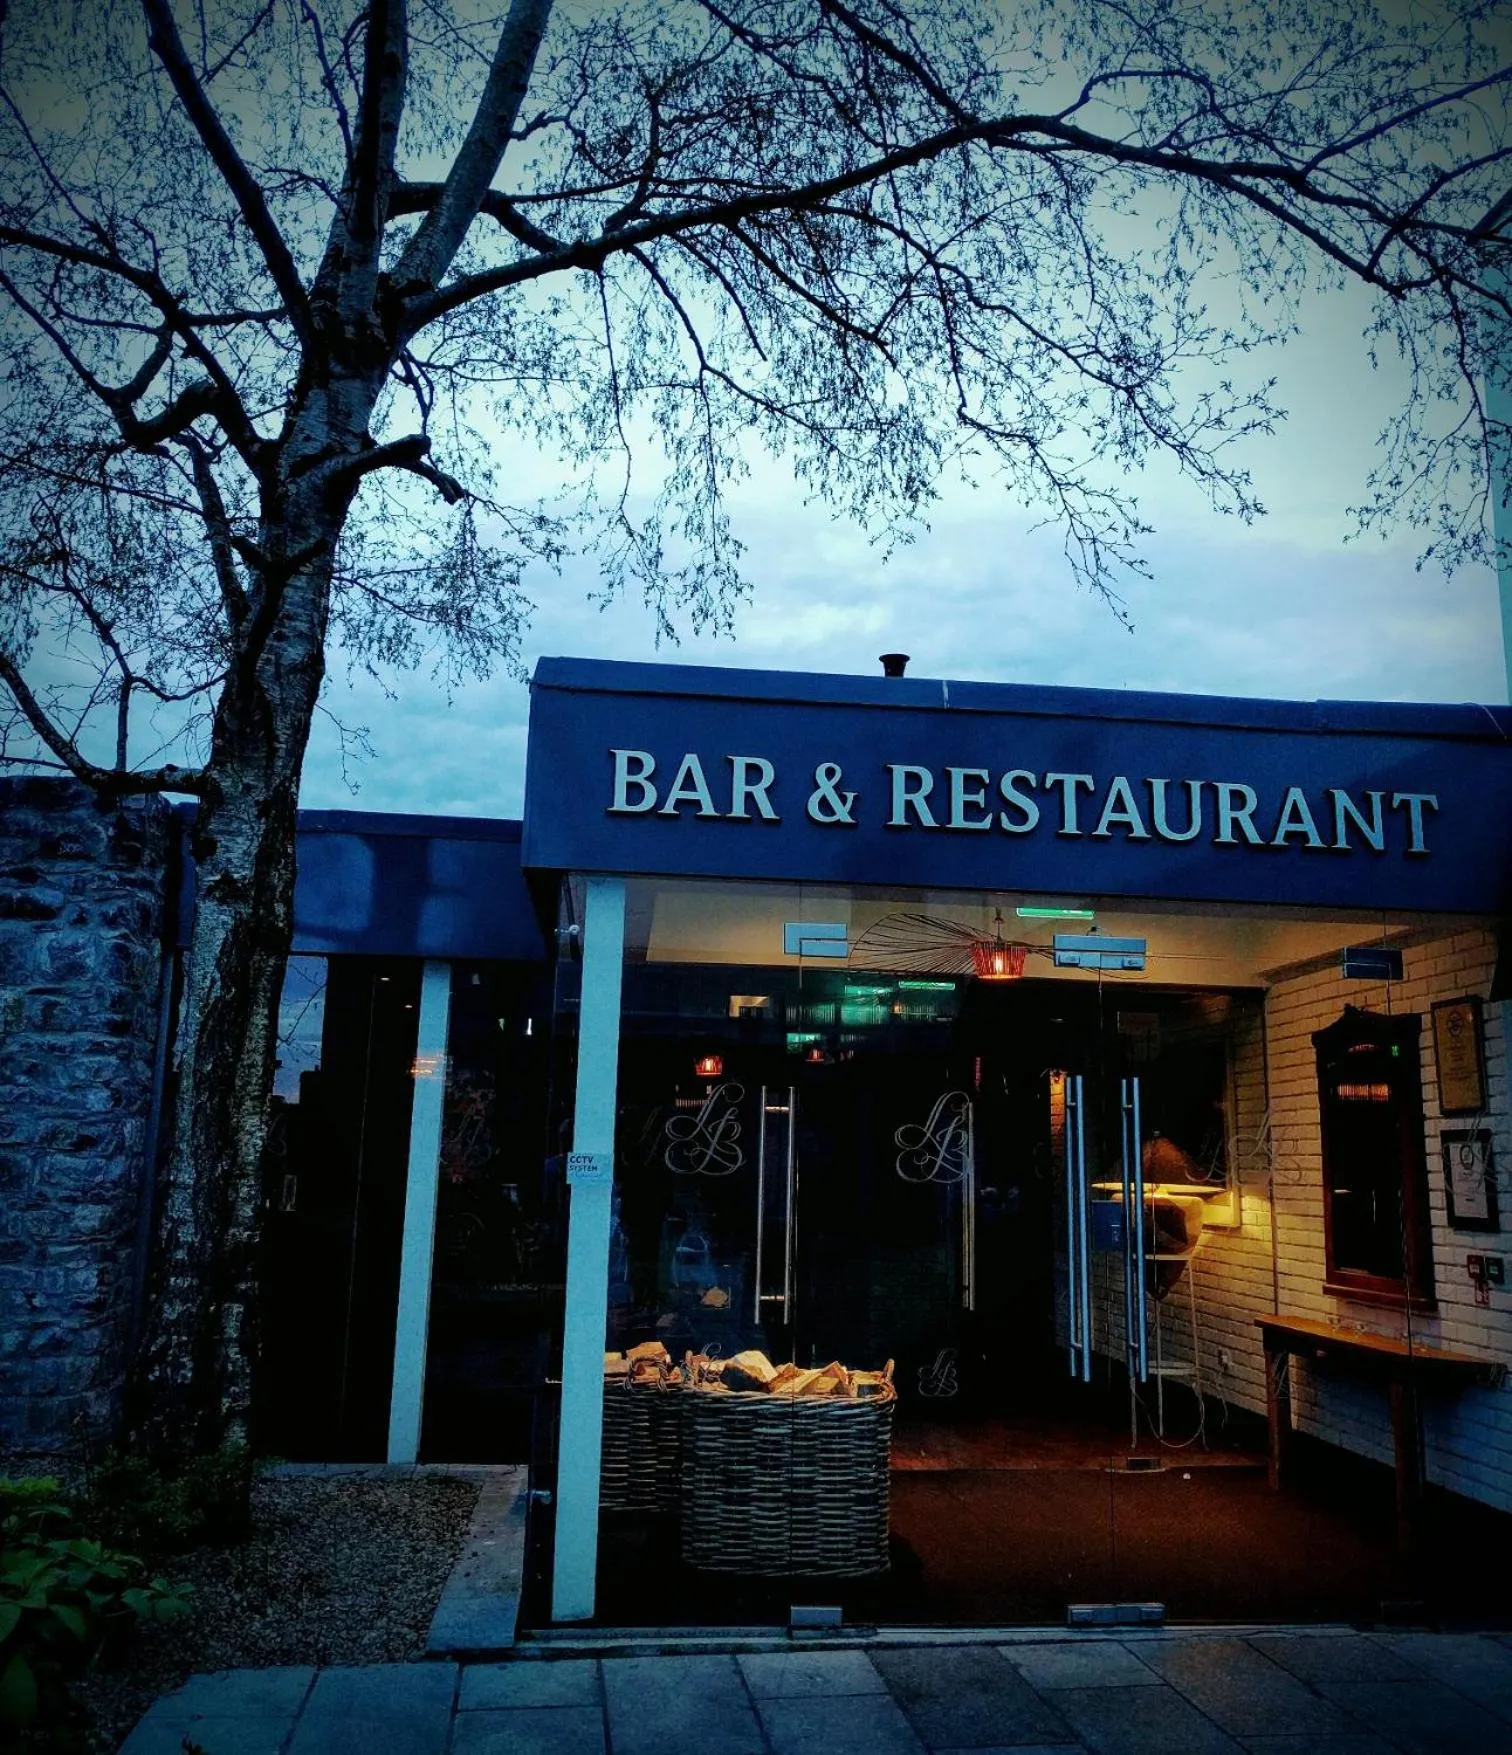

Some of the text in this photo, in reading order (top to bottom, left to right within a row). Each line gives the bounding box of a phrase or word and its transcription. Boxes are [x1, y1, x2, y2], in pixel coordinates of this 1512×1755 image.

[607, 749, 1440, 856] BAR & RESTAURANT
